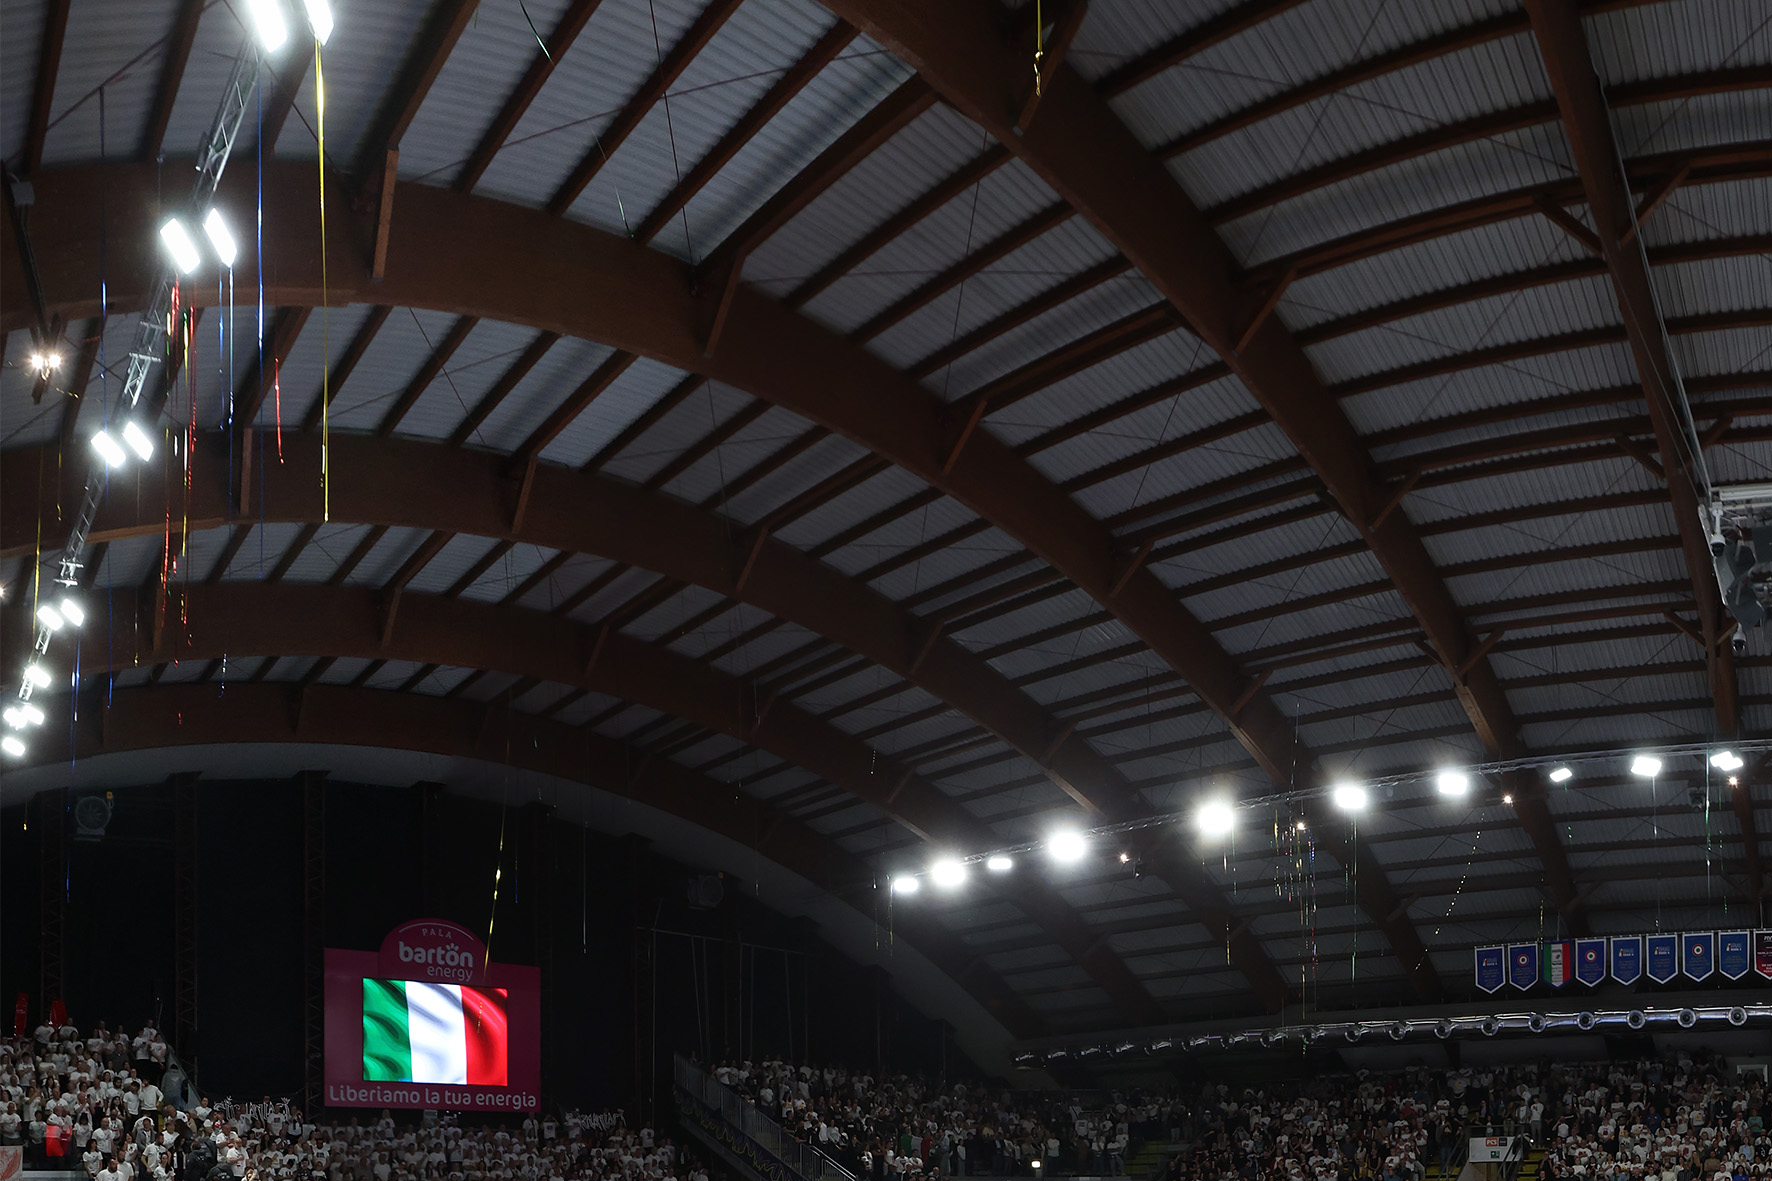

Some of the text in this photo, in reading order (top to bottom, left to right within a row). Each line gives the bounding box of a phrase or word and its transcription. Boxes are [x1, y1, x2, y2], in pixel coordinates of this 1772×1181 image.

[422, 928, 451, 938] PALA
[399, 943, 473, 967] barton
[427, 965, 473, 981] energy
[330, 1085, 537, 1109] Liberiamo la tua energia
